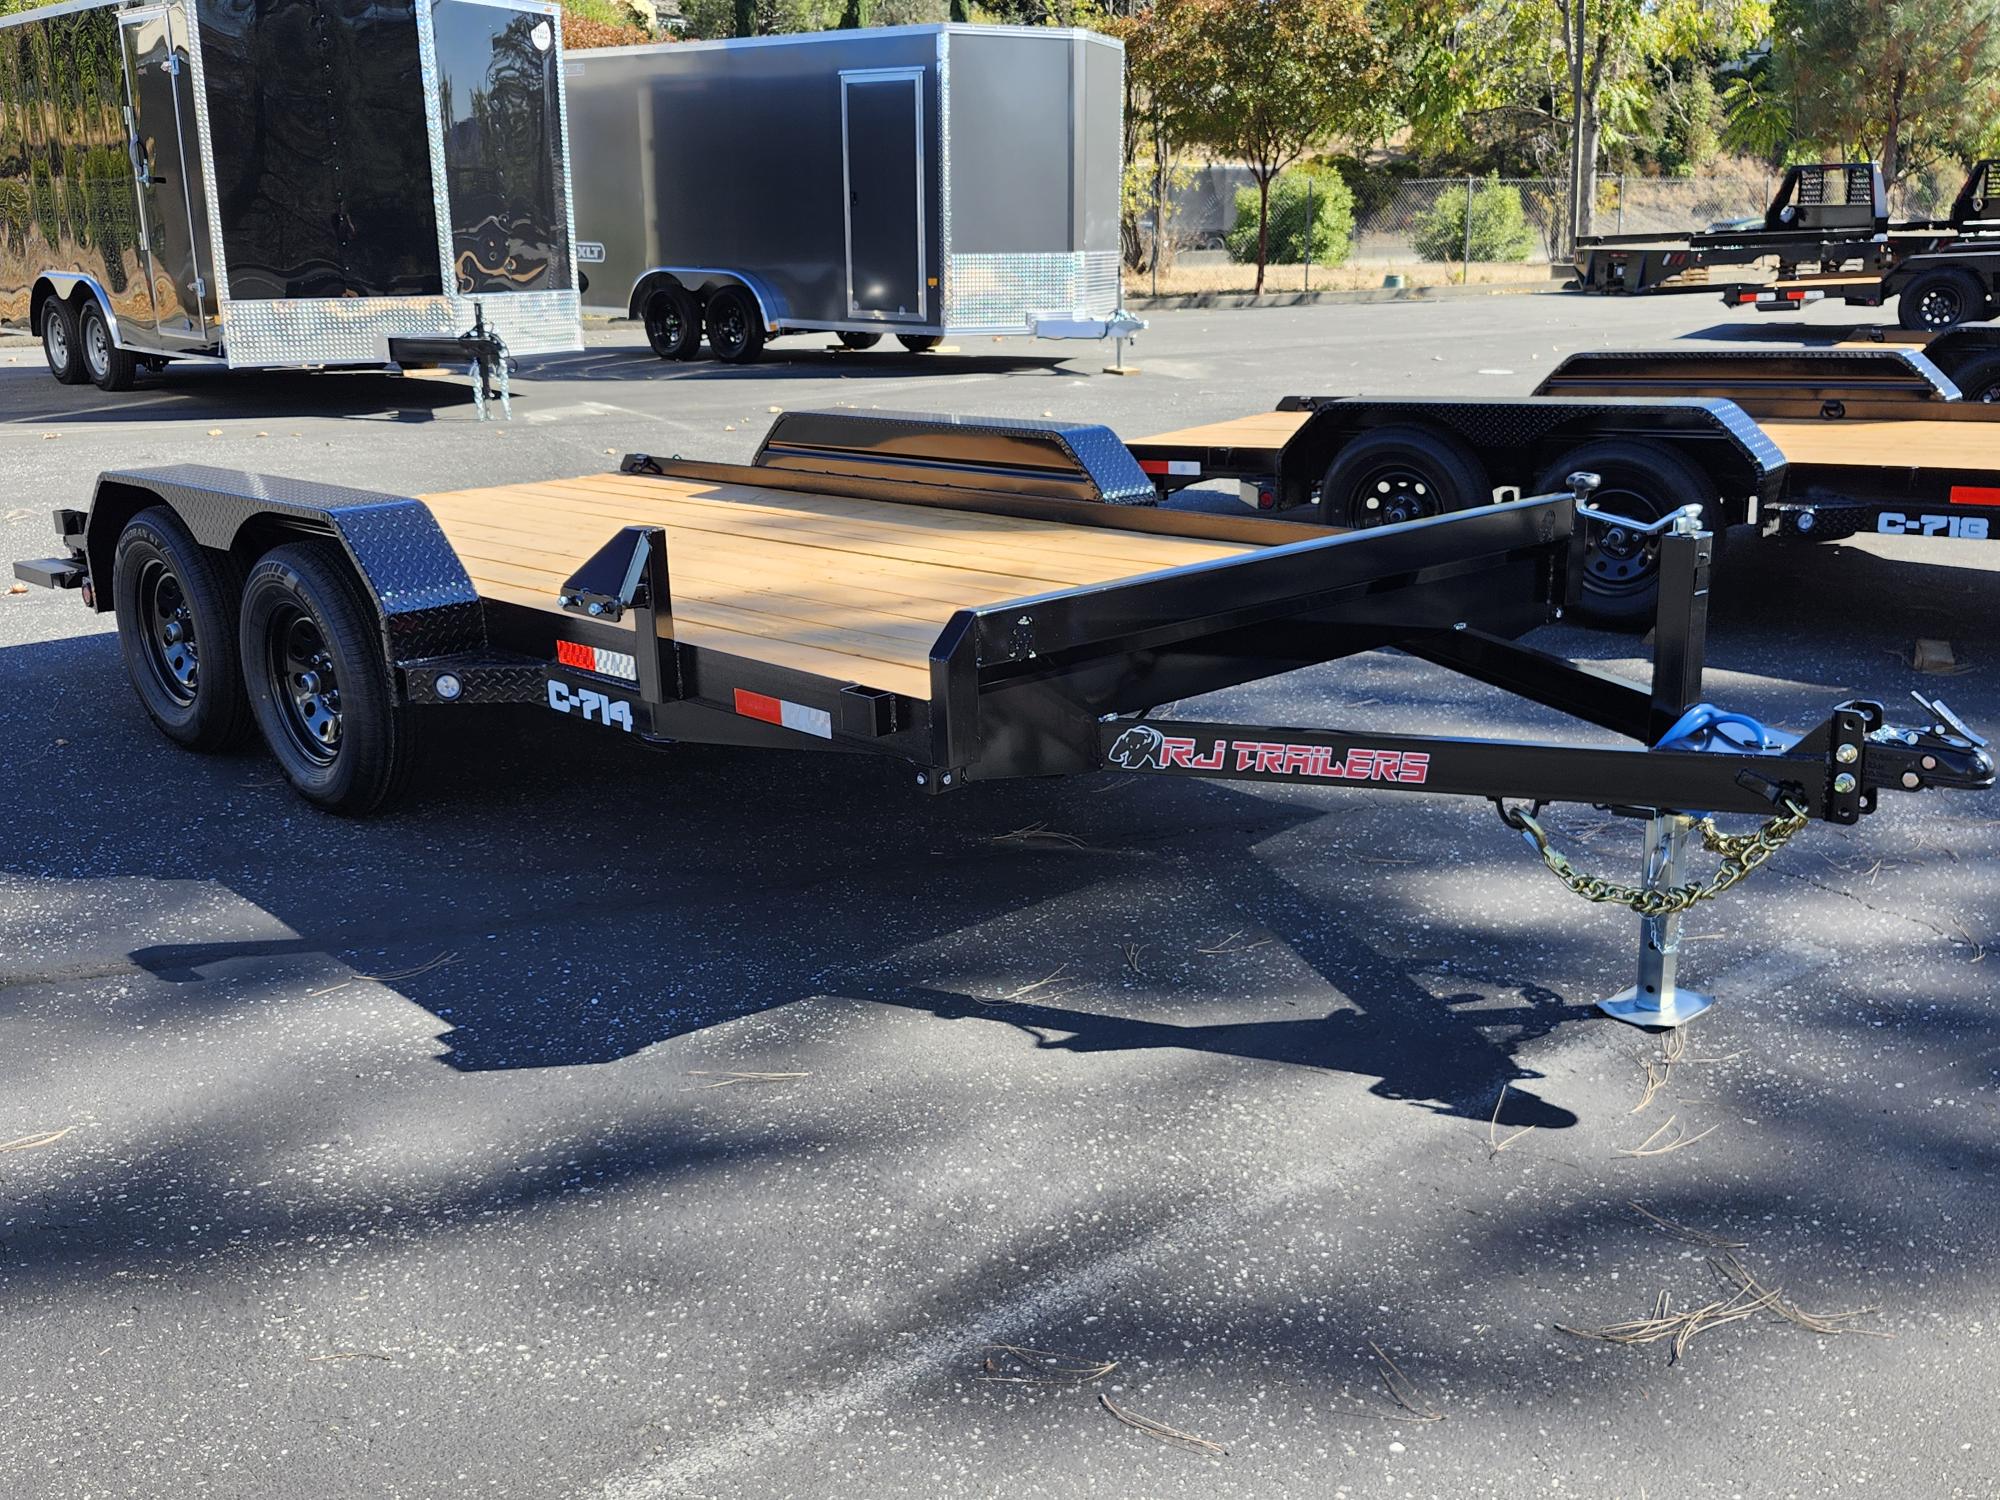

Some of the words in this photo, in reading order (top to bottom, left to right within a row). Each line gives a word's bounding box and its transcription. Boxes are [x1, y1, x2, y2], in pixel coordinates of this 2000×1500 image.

[577, 246, 601, 258] XLT
[1878, 512, 1988, 539] C-718
[548, 680, 633, 732] C-714
[1160, 737, 1226, 770] RJ
[1232, 741, 1430, 784] TRAILERS
